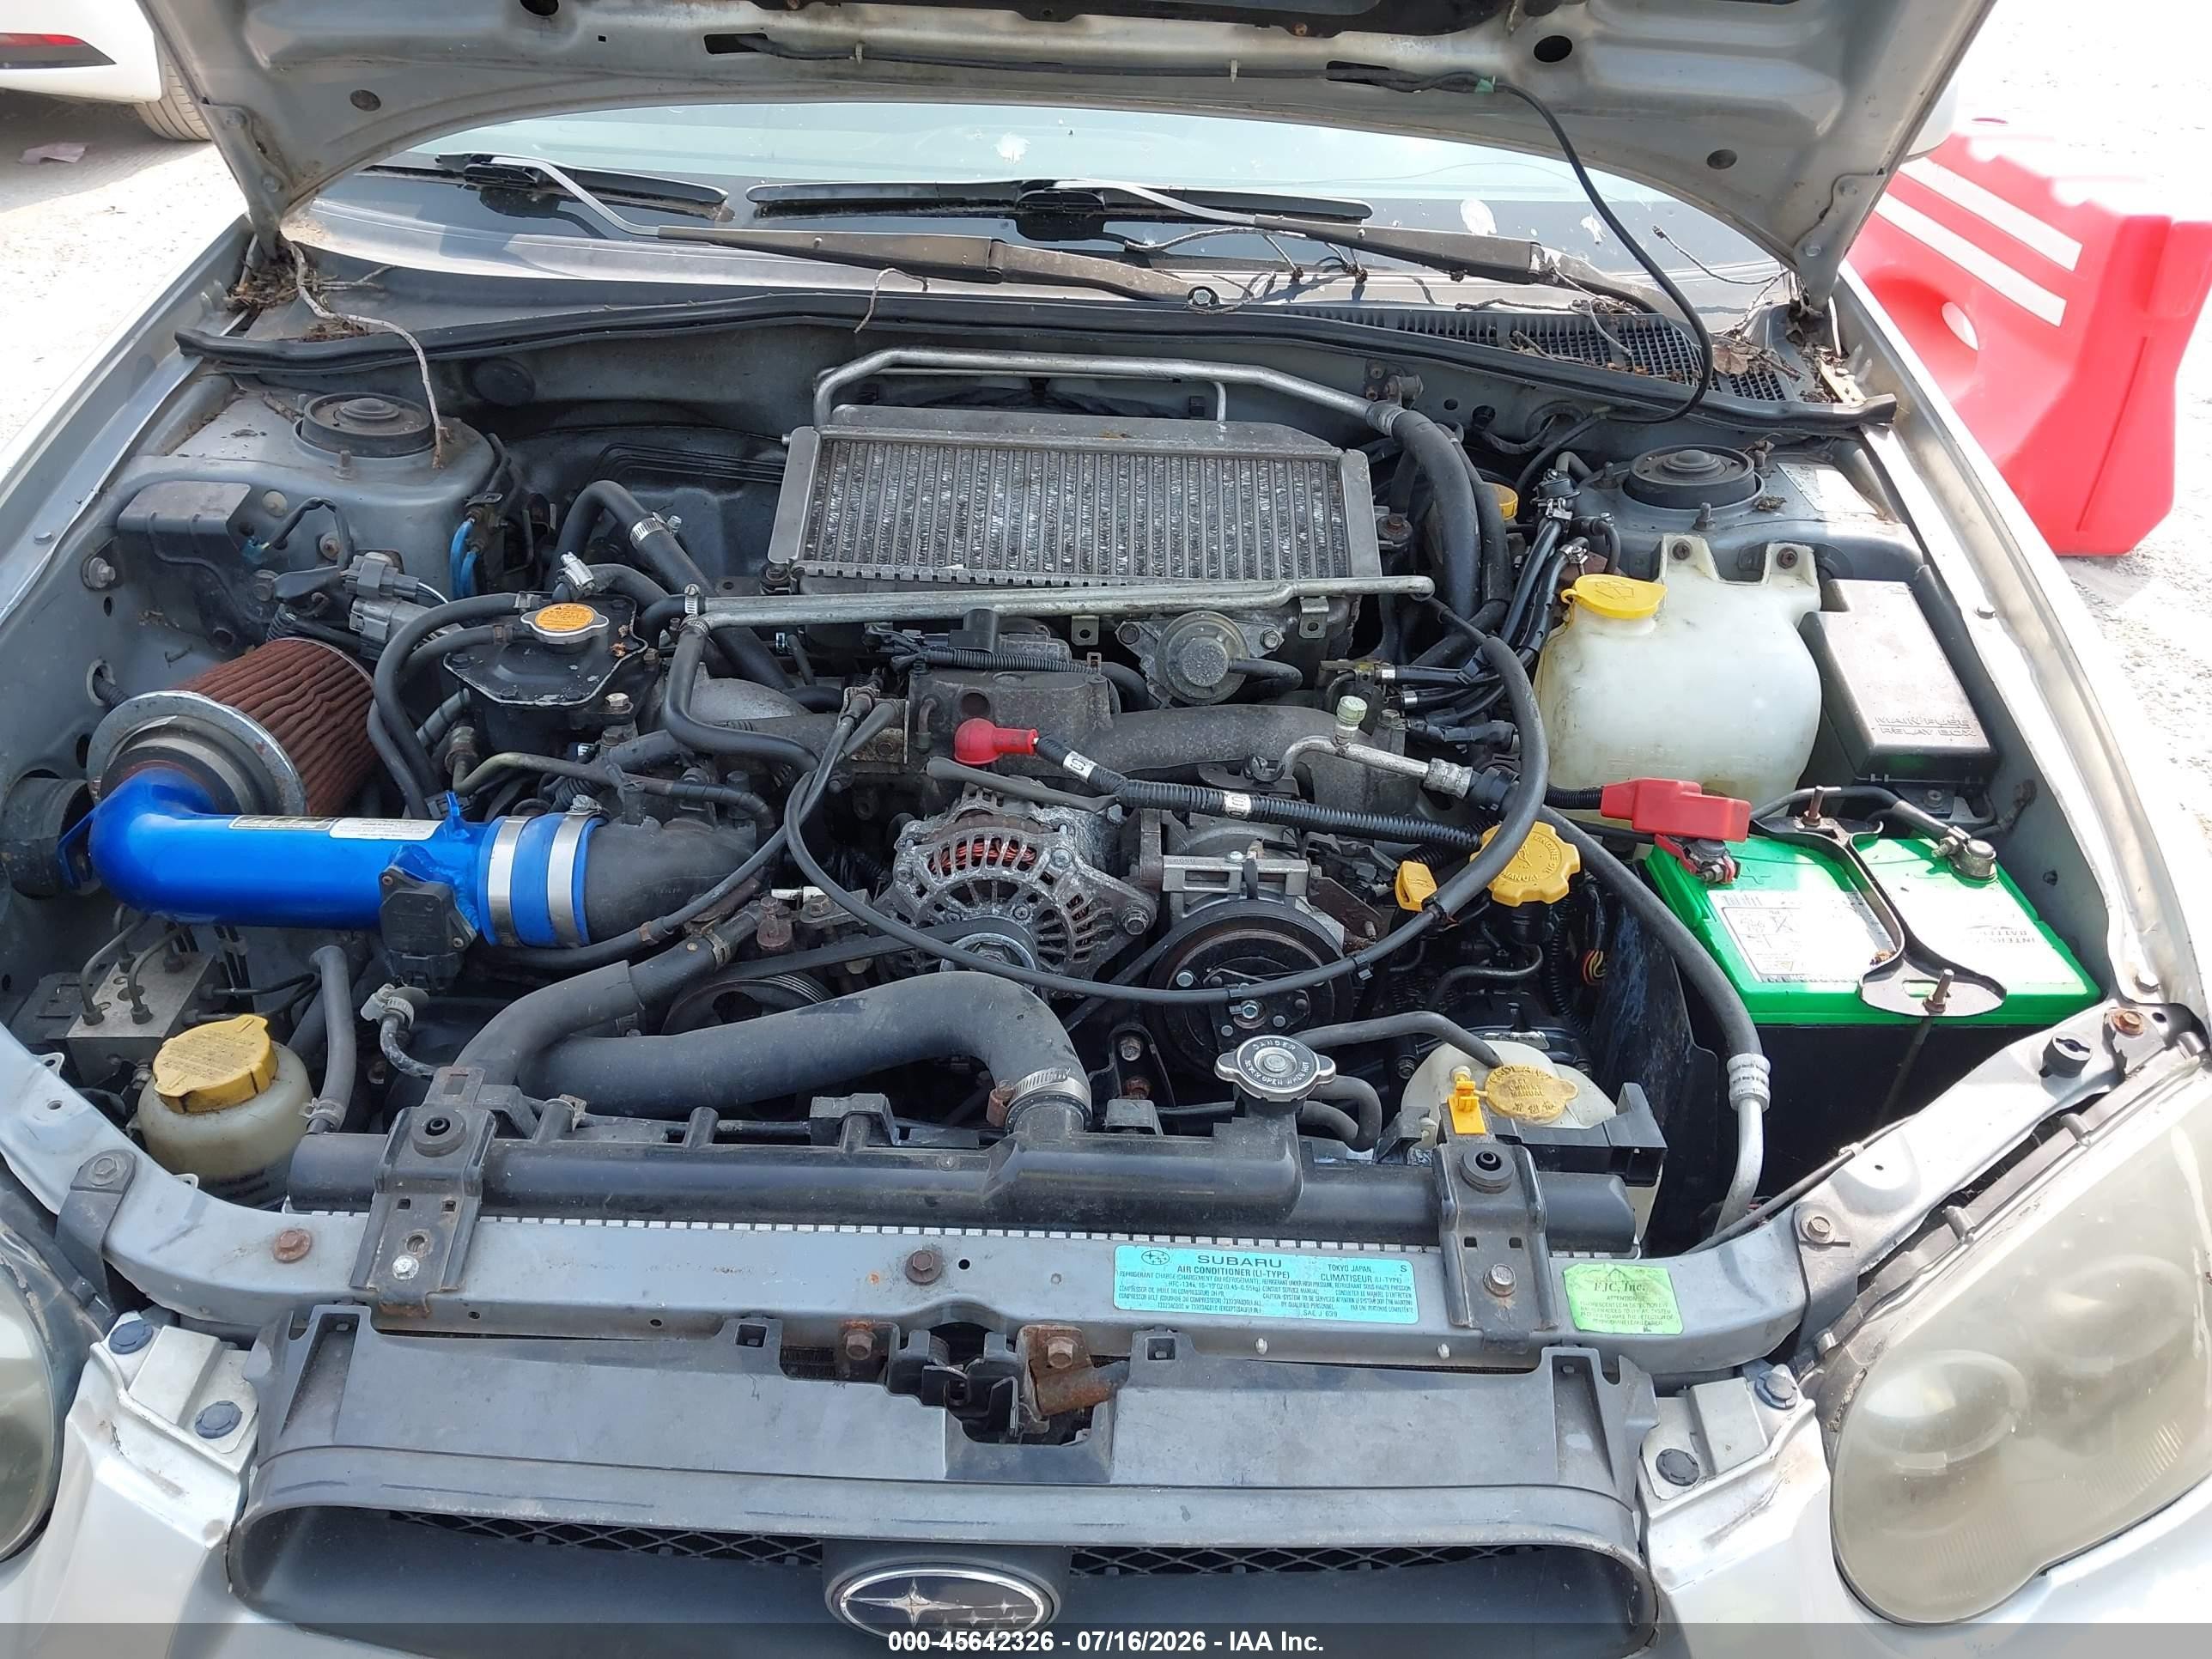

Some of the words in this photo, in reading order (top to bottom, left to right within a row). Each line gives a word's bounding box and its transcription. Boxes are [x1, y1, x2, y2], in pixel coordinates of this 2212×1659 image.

[1879, 726, 1933, 736] RELAY
[1937, 727, 1978, 737] BOX
[1252, 1039, 1297, 1050] DANGER
[1261, 1075, 1284, 1086] OPEN
[1287, 1072, 1306, 1085] WHEN
[1197, 1255, 1282, 1268] SUBARU
[1177, 1265, 1192, 1273] AIR
[1194, 1266, 1251, 1277] CONDITIONER
[1252, 1269, 1290, 1279] (LI-TYPE)
[1401, 1264, 1408, 1273] S
[1321, 1273, 1373, 1283] CLIMATISEUR
[1593, 1281, 1621, 1294] FJC,
[1624, 1280, 1646, 1292] Inc.
